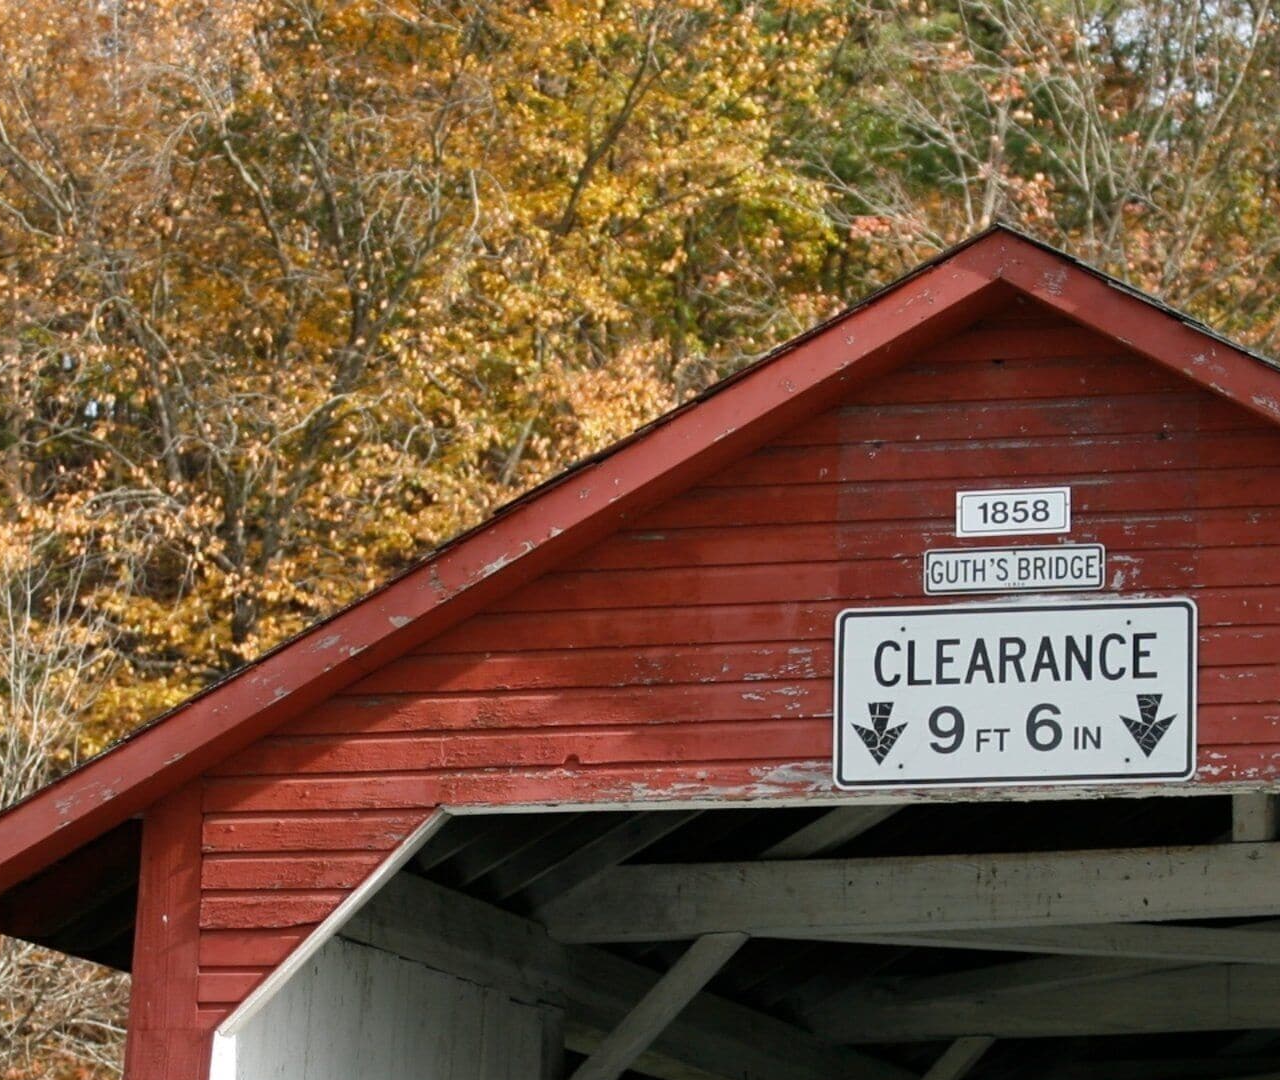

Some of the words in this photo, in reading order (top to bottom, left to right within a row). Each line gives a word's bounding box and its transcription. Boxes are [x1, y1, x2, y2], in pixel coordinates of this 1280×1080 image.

[977, 499, 1050, 525] 1858
[930, 557, 1009, 585] GUTH'S
[1019, 555, 1098, 581] BRIDGE
[874, 632, 1158, 687] CLEARANCE
[928, 705, 965, 754] 9
[975, 729, 1010, 752] FT
[1025, 703, 1063, 751] 6
[1074, 726, 1101, 750] IN
